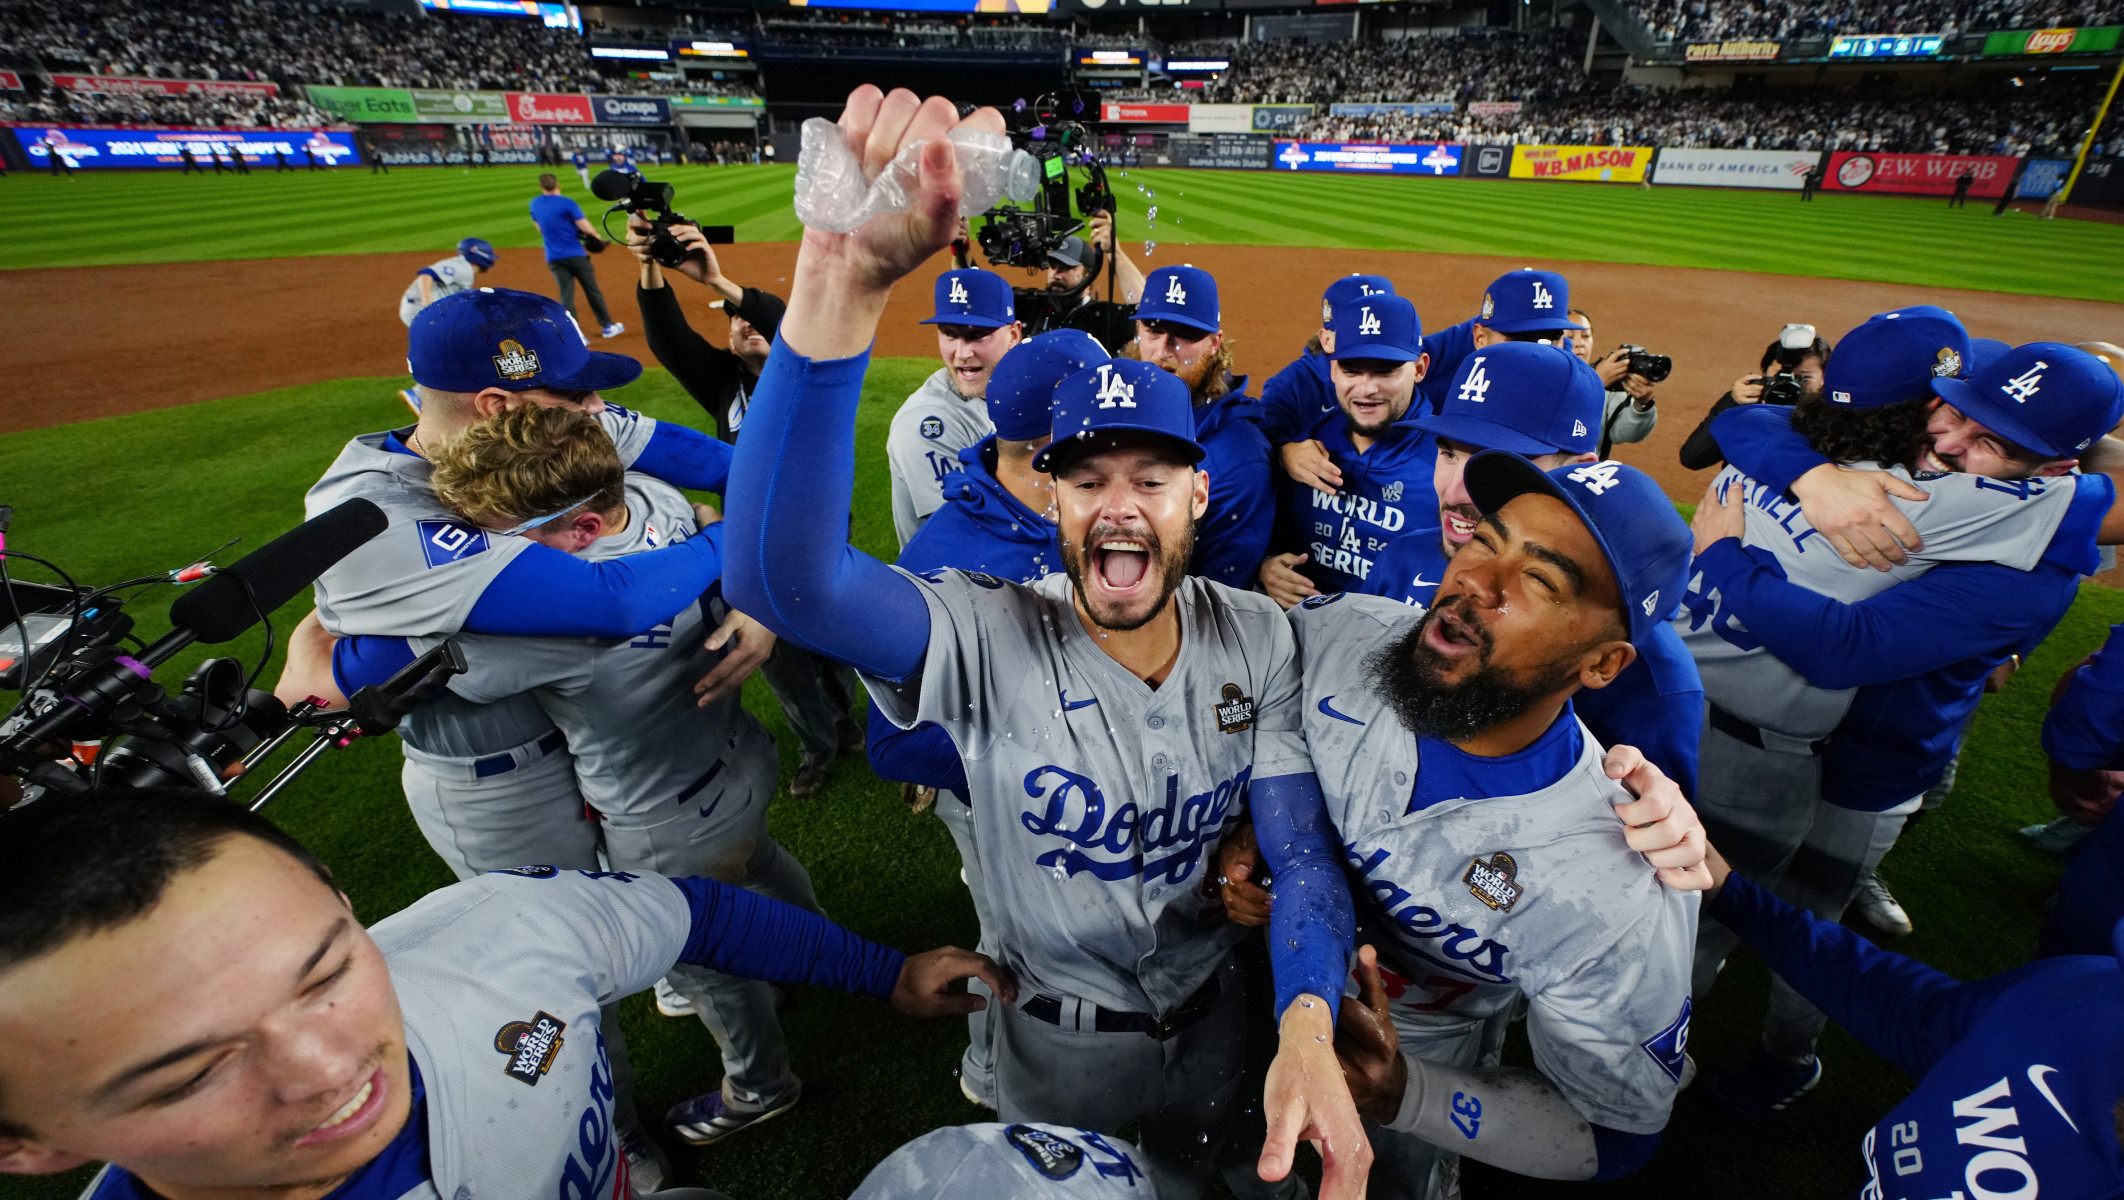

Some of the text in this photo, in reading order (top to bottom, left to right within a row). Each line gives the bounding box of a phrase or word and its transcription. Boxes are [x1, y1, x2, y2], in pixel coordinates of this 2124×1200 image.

[1685, 41, 1780, 57] Parts Authority
[364, 97, 412, 113] Eats
[621, 101, 658, 115] coupa
[1121, 108, 1148, 117] TOYOTA
[1660, 162, 1779, 174] BANK OF AMERICA
[1876, 158, 1920, 177] F.W.
[949, 277, 968, 304] LA
[1166, 276, 1186, 305] LA
[1533, 282, 1553, 309] LA
[1359, 306, 1381, 335] LA
[496, 354, 536, 368] WORLD
[500, 361, 538, 374] SERIES
[1096, 364, 1137, 409] LA
[1458, 357, 1491, 403] LA
[2001, 361, 2049, 404] LA
[1567, 459, 1622, 496] LA
[1312, 487, 1405, 532] WORLD
[432, 524, 468, 551] G
[1314, 521, 1333, 538] 20
[1310, 541, 1374, 580] SERIE
[1218, 702, 1252, 717] WORLD
[1221, 710, 1252, 726] SERIES
[1470, 873, 1510, 905] SERIES
[1473, 863, 1516, 898] WORLD
[512, 1018, 550, 1071] WORLD
[524, 1024, 558, 1076] SERIES
[1450, 1091, 1482, 1140] 37
[1892, 1120, 1923, 1176] 20
